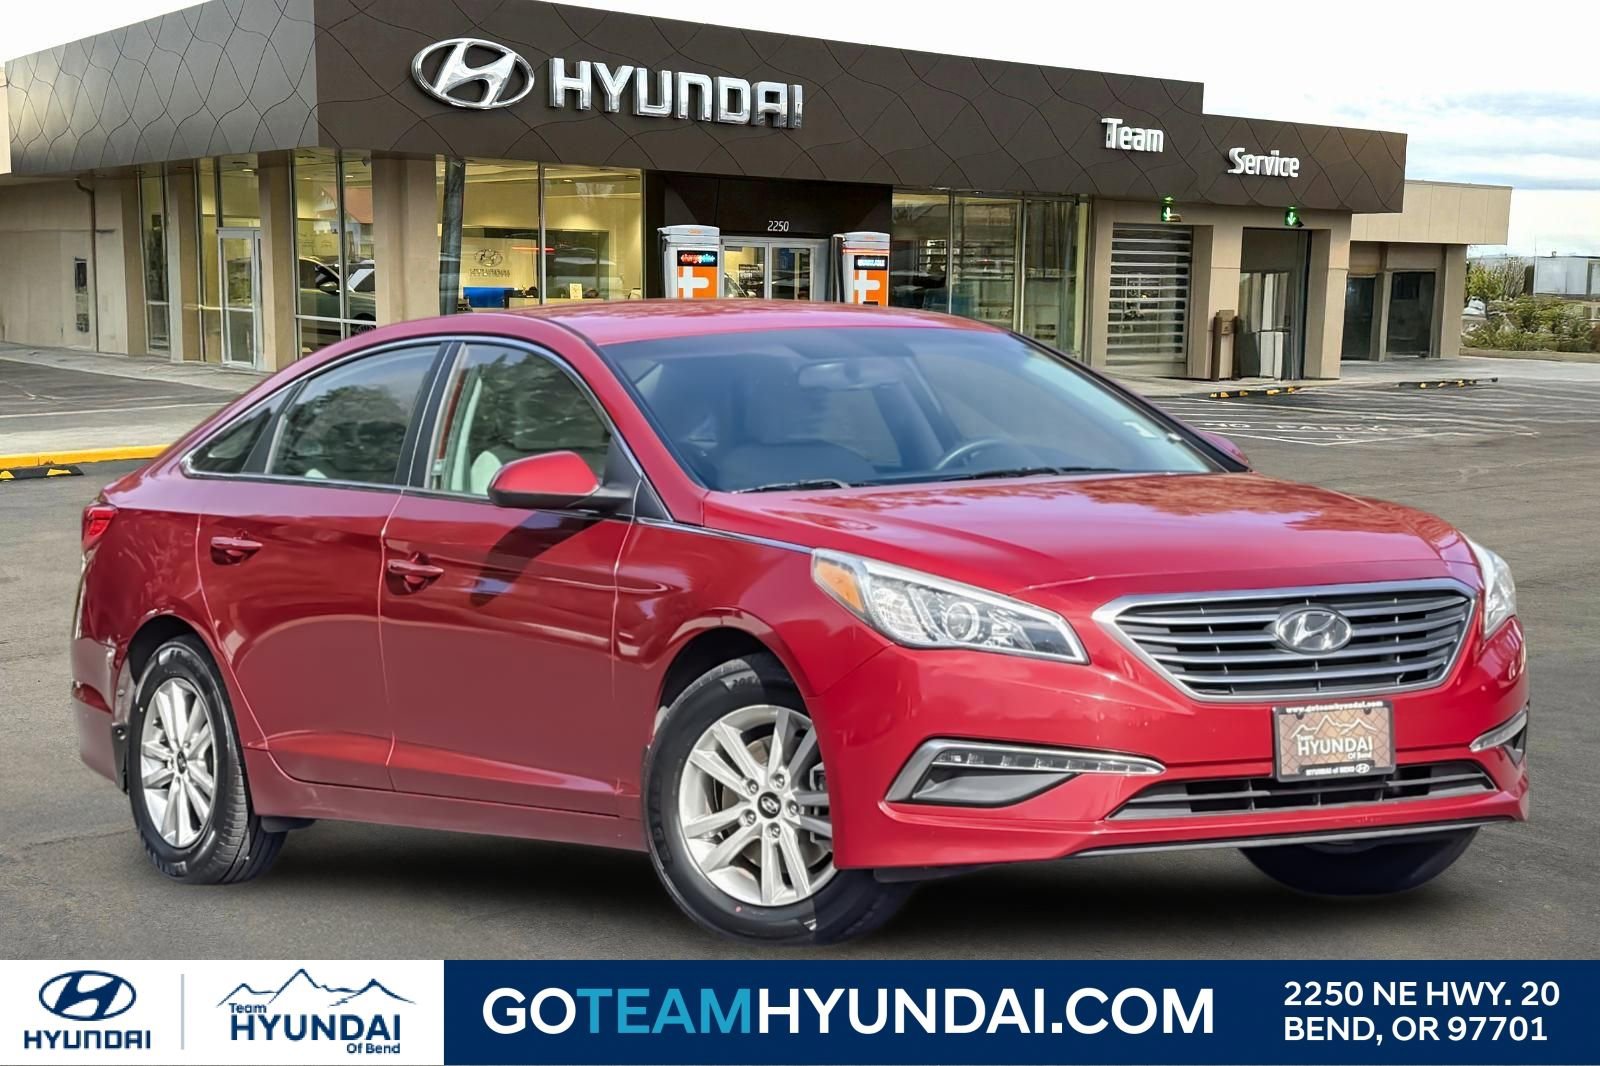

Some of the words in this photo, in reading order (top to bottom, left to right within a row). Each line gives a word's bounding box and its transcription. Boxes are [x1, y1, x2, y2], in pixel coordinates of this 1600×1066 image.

[548, 56, 803, 129] HYUNDAI
[1101, 117, 1164, 153] Team
[1227, 147, 1300, 178] Service
[767, 220, 790, 232] 2250
[1297, 736, 1373, 756] HYUNDAI
